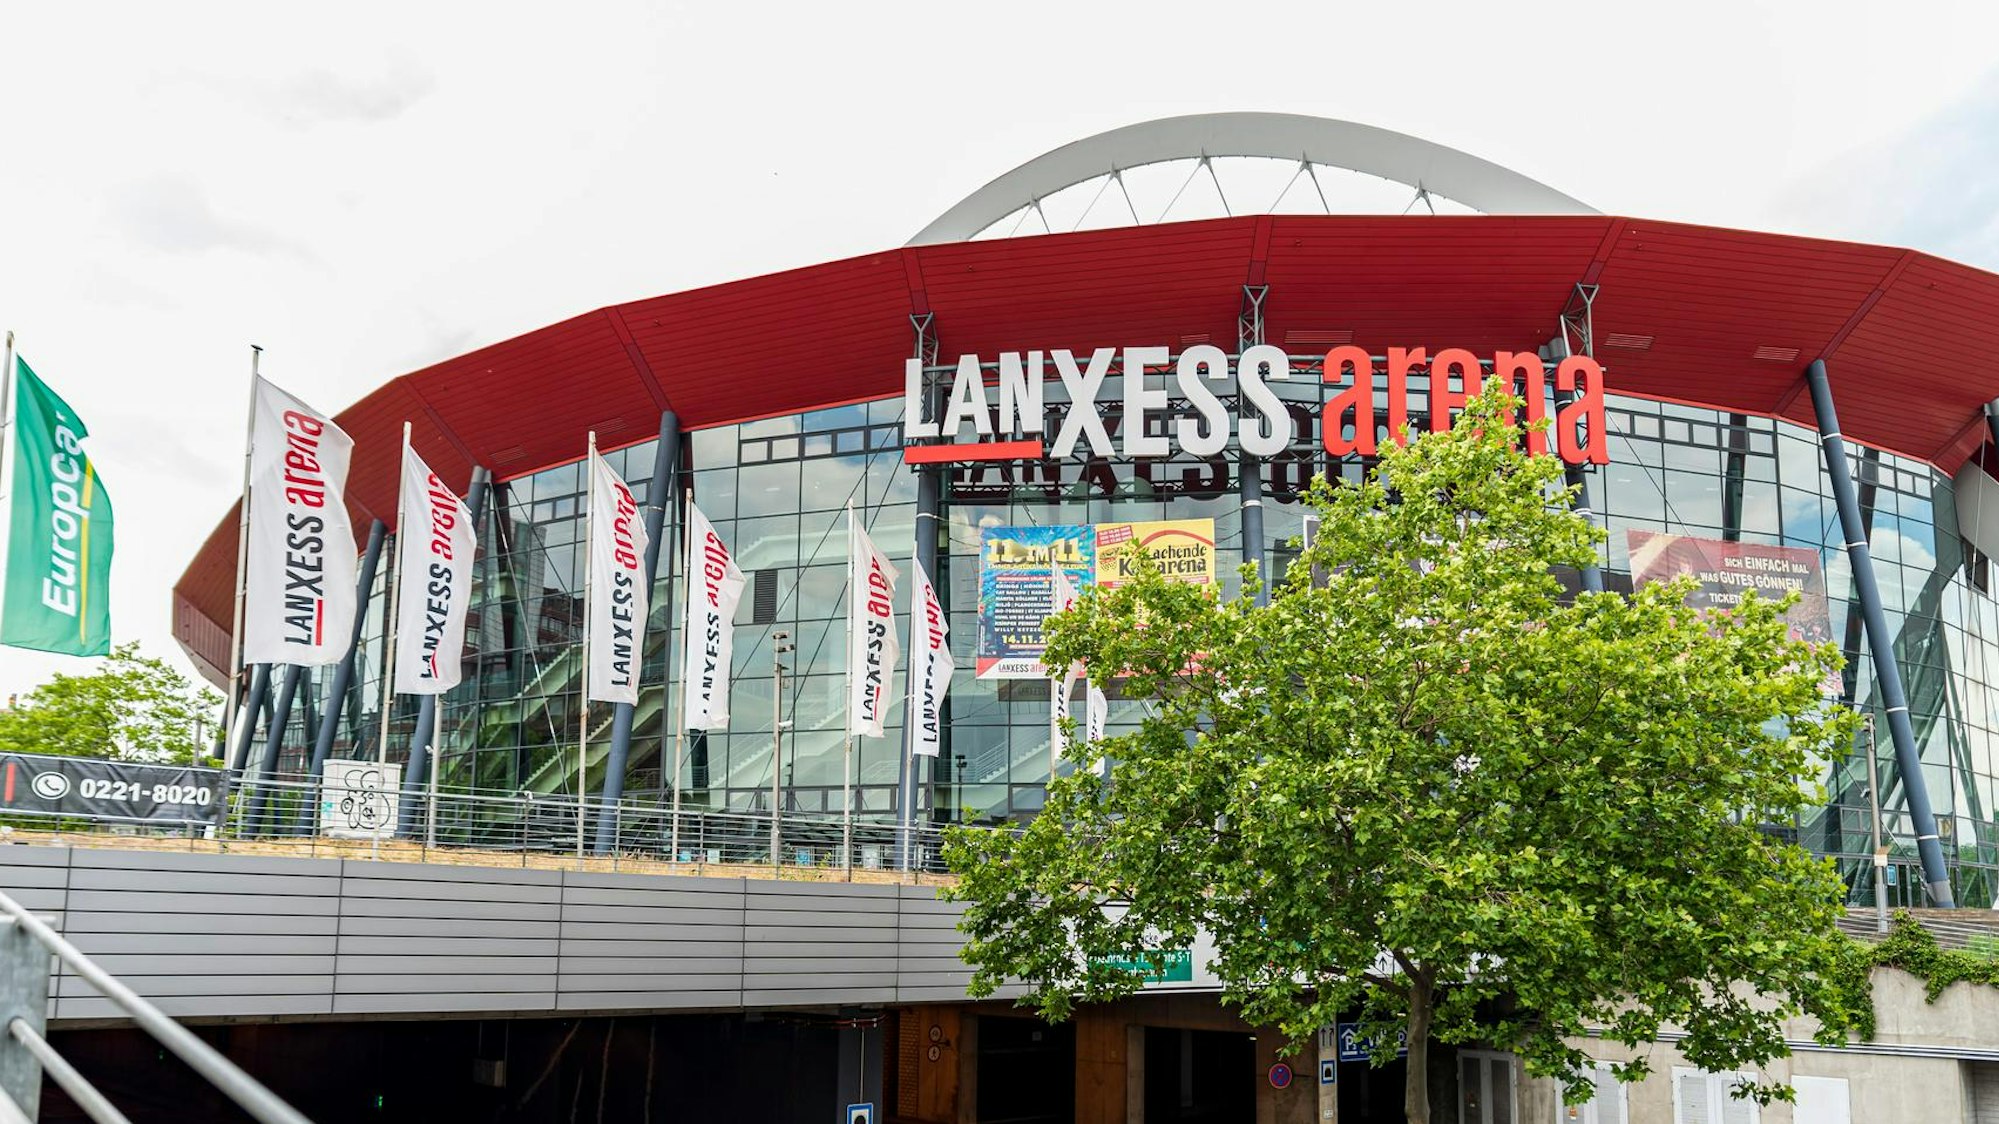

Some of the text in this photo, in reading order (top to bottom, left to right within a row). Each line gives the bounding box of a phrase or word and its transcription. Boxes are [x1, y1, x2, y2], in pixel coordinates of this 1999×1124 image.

[905, 345, 1611, 465] LANXESS arena
[41, 410, 90, 617] Europcar
[282, 409, 325, 645] LANXESS arena
[1149, 543, 1207, 560] achende
[1118, 557, 1207, 577] Karena
[1700, 571, 1804, 591] WAS GUTES GÖNNEN!
[1724, 556, 1809, 574] SICH EINFACH MAL
[420, 562, 452, 679] LANXESS
[611, 571, 633, 686] LANXESS
[702, 611, 720, 714] ANXESS
[862, 620, 886, 721] LANXESS
[998, 663, 1029, 673] LANXESS
[79, 778, 211, 806] 0221-8020
